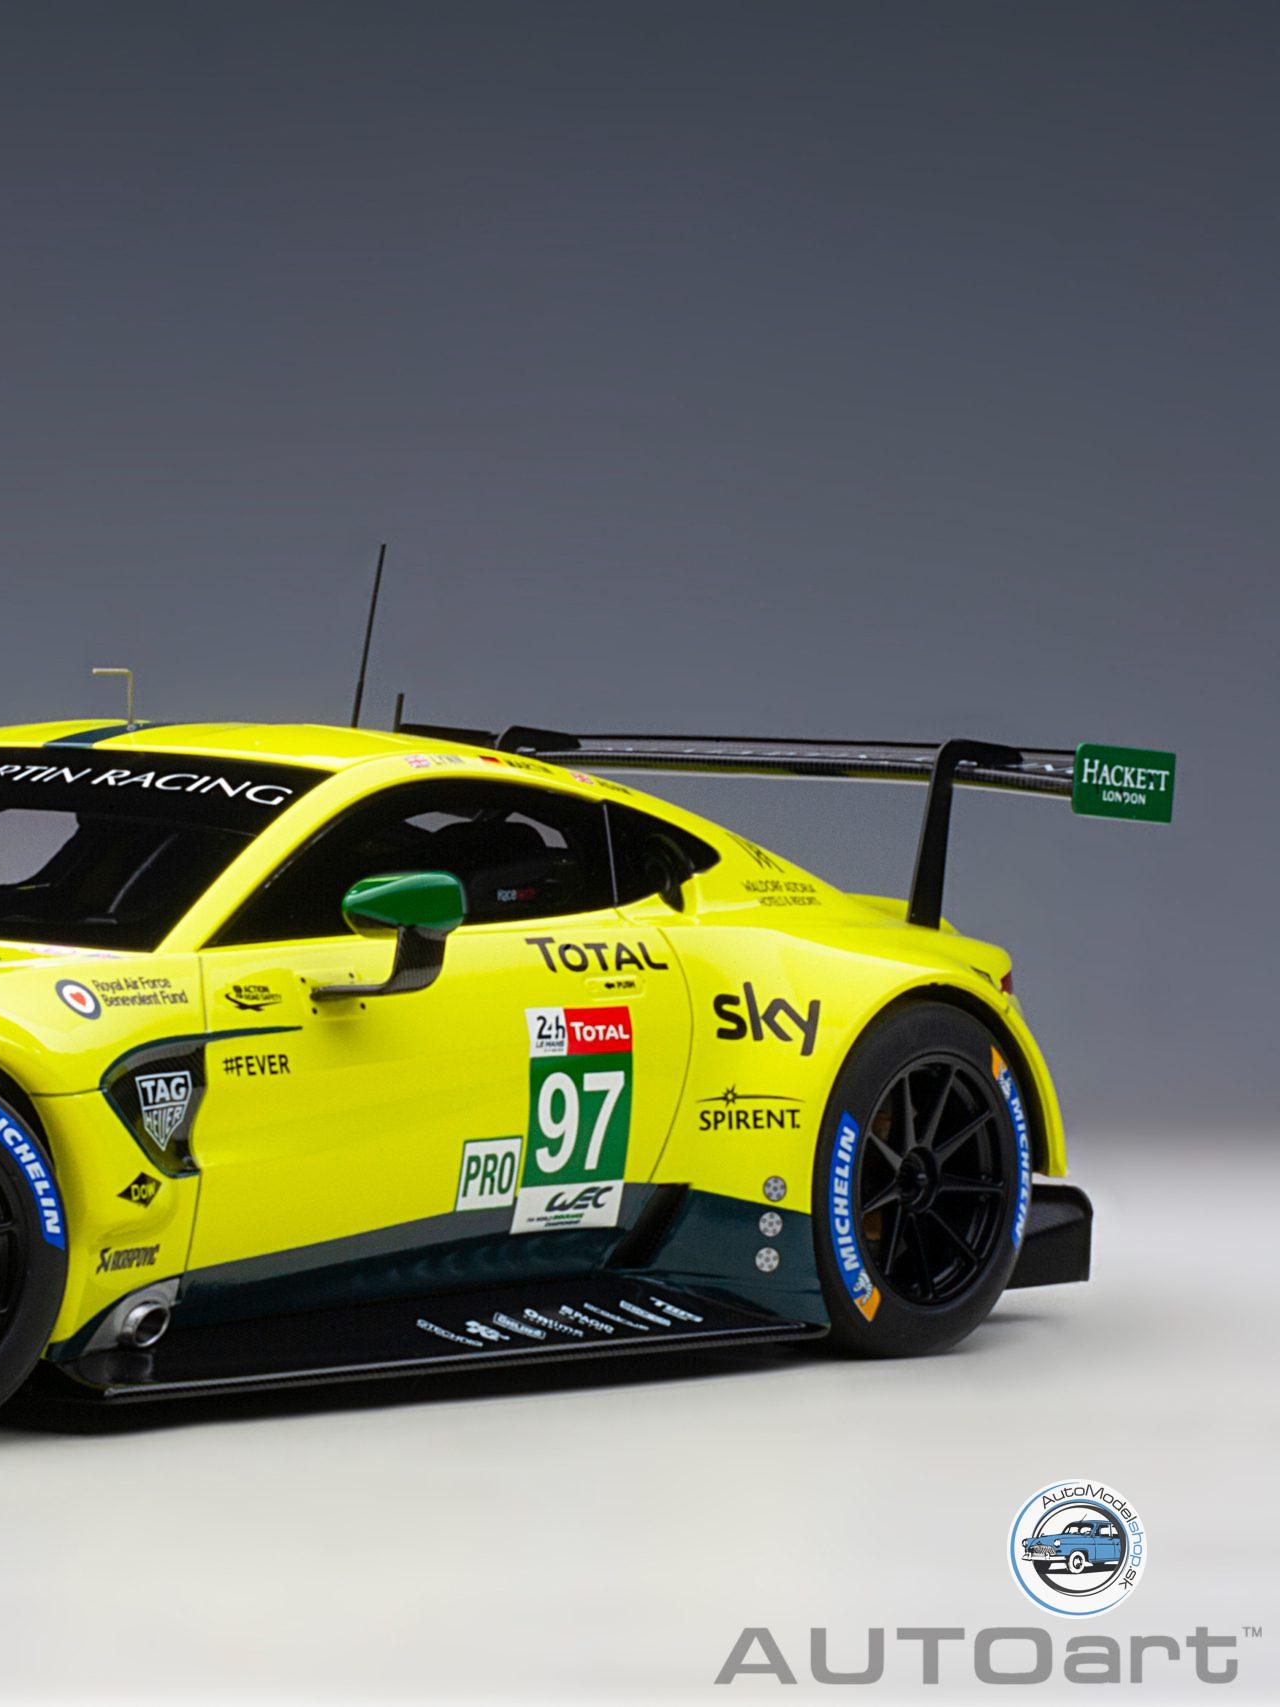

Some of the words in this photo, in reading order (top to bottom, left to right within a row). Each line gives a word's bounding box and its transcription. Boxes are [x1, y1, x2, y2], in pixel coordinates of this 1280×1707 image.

[91, 768, 293, 806] RACING
[1081, 758, 1170, 792] HACKETT
[1102, 789, 1147, 805] LONDON
[524, 935, 669, 974] TOTAL
[91, 978, 121, 994] Royal
[123, 977, 140, 990] Air
[139, 976, 171, 990] Force
[101, 991, 160, 1007] Benevolent
[161, 990, 189, 1005] Fund
[569, 1021, 630, 1042] TOTAL
[712, 980, 821, 1057] sky
[222, 1053, 291, 1078] #FEVER
[140, 1077, 187, 1104] TAG
[144, 1106, 183, 1143] HEUER
[534, 1070, 626, 1175] 97
[461, 1150, 517, 1199] PRO
[544, 1185, 614, 1213] WEC
[832, 1125, 857, 1273] MICHELIN
